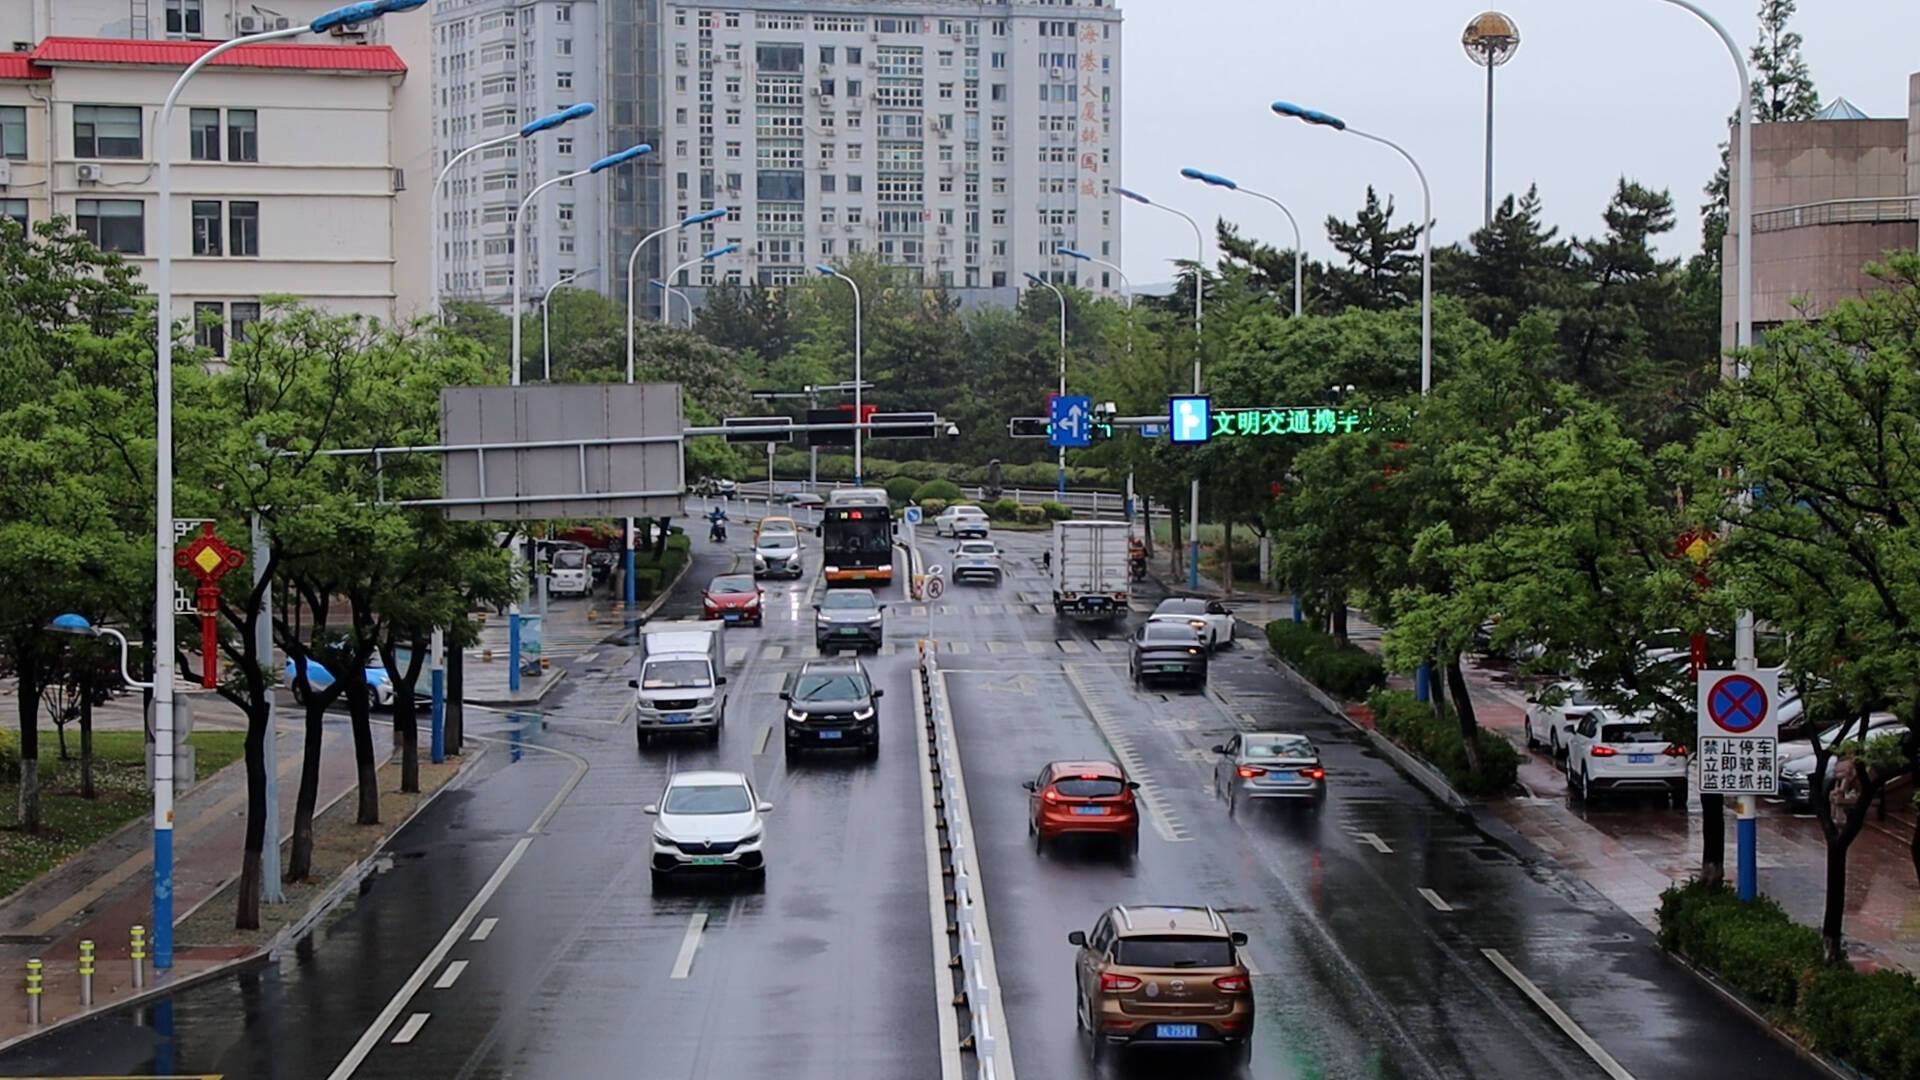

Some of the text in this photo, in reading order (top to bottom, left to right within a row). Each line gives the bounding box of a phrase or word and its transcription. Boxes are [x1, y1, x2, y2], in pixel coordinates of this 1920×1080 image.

[1211, 407, 1412, 436] 文明交通携手
[1703, 739, 1772, 755] 禁止停车
[1703, 756, 1772, 773] 立即驶离
[1703, 774, 1772, 790] 监控抓拍
